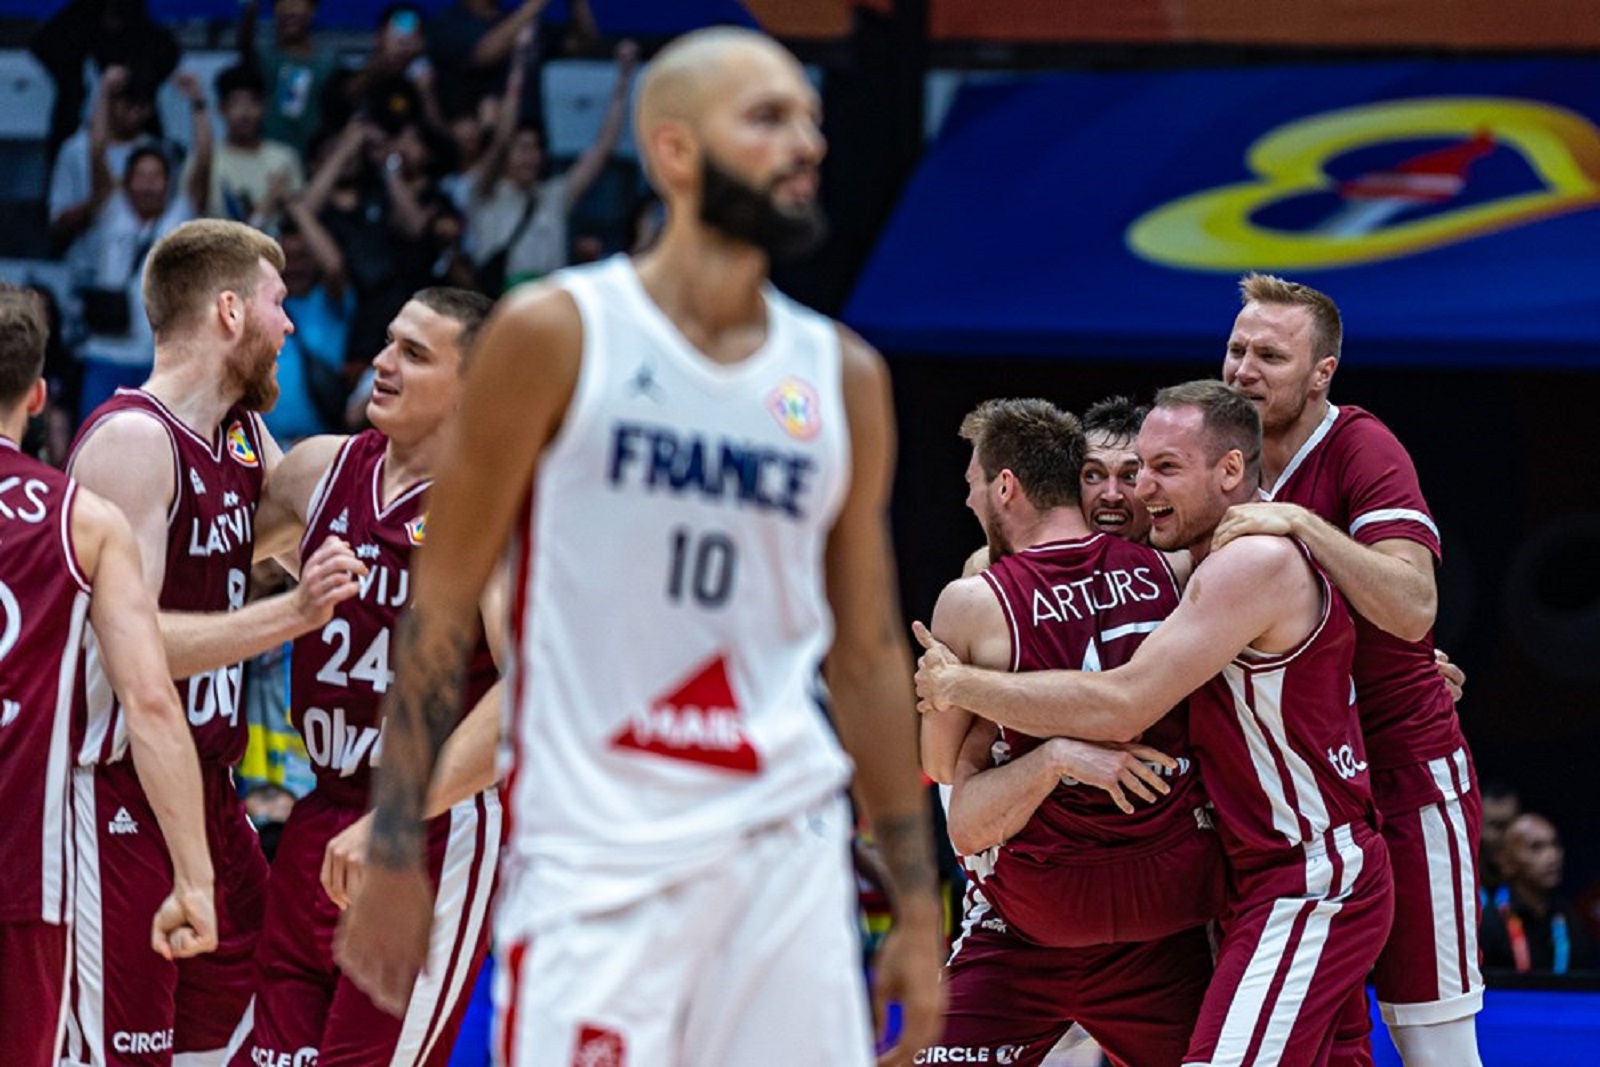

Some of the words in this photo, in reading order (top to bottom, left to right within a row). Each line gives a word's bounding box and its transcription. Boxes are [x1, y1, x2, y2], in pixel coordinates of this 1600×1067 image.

[608, 422, 816, 520] FRANCE
[188, 502, 256, 557] LATVI
[667, 526, 737, 608] 10
[316, 617, 395, 693] 24
[913, 1046, 989, 1064] CIRCLE
